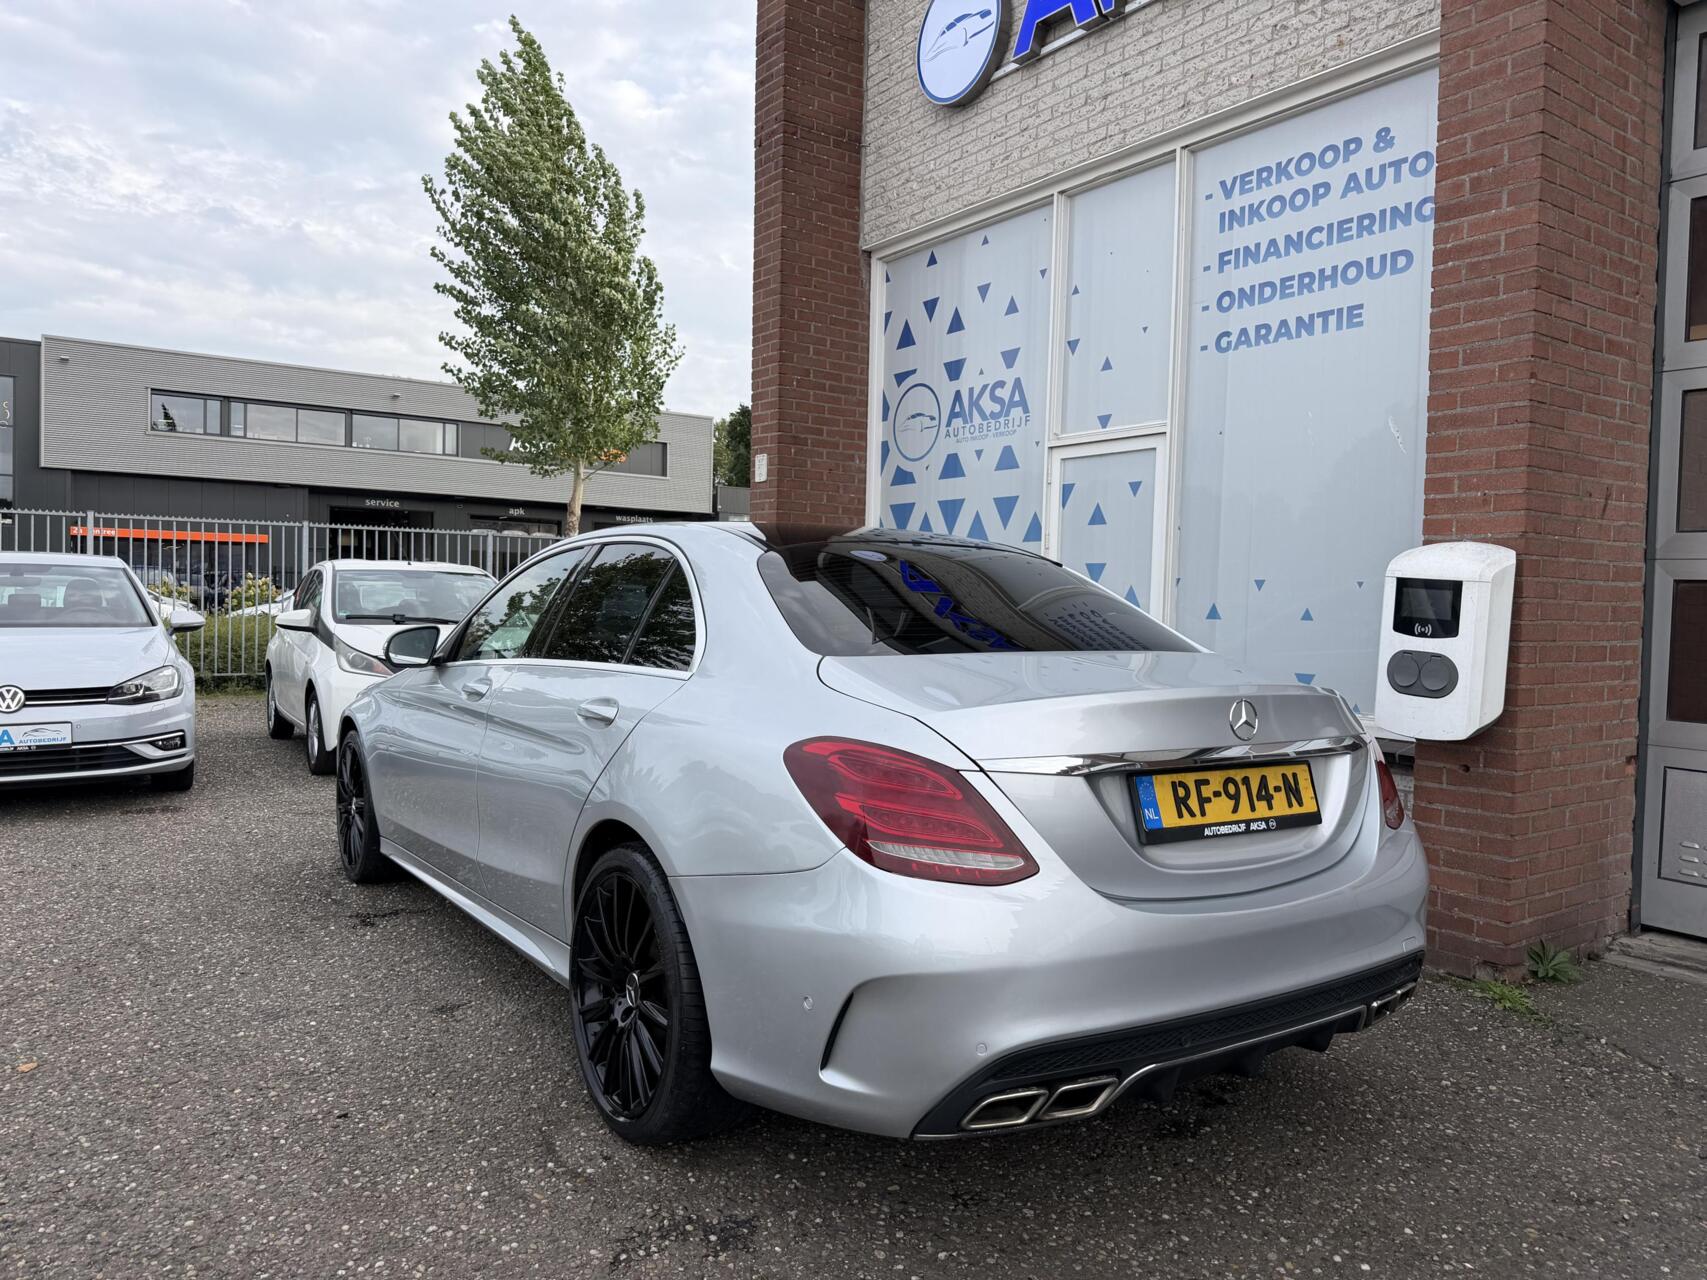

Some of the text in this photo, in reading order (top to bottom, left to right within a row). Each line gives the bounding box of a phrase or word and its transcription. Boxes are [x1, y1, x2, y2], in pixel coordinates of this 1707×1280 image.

[1218, 136, 1363, 201] VERKOOP
[1372, 126, 1396, 153] &
[1218, 150, 1435, 234] INKOOP AUTO
[1217, 195, 1435, 274] FINANCIERING
[1216, 249, 1414, 314] ONDERHOUD
[1214, 303, 1364, 354] GARANTIE
[945, 376, 1030, 428] AKSA
[944, 415, 1031, 439] AUTOBEDRIJF
[365, 498, 400, 508] service
[508, 507, 525, 516] apk
[615, 514, 654, 524] wasplaats
[19, 736, 67, 745] AUTOBEDRIJF
[1170, 772, 1304, 819] RF-914-N
[1144, 808, 1159, 820] NL
[1203, 821, 1267, 837] AUTOBEDRIJF AKSA
